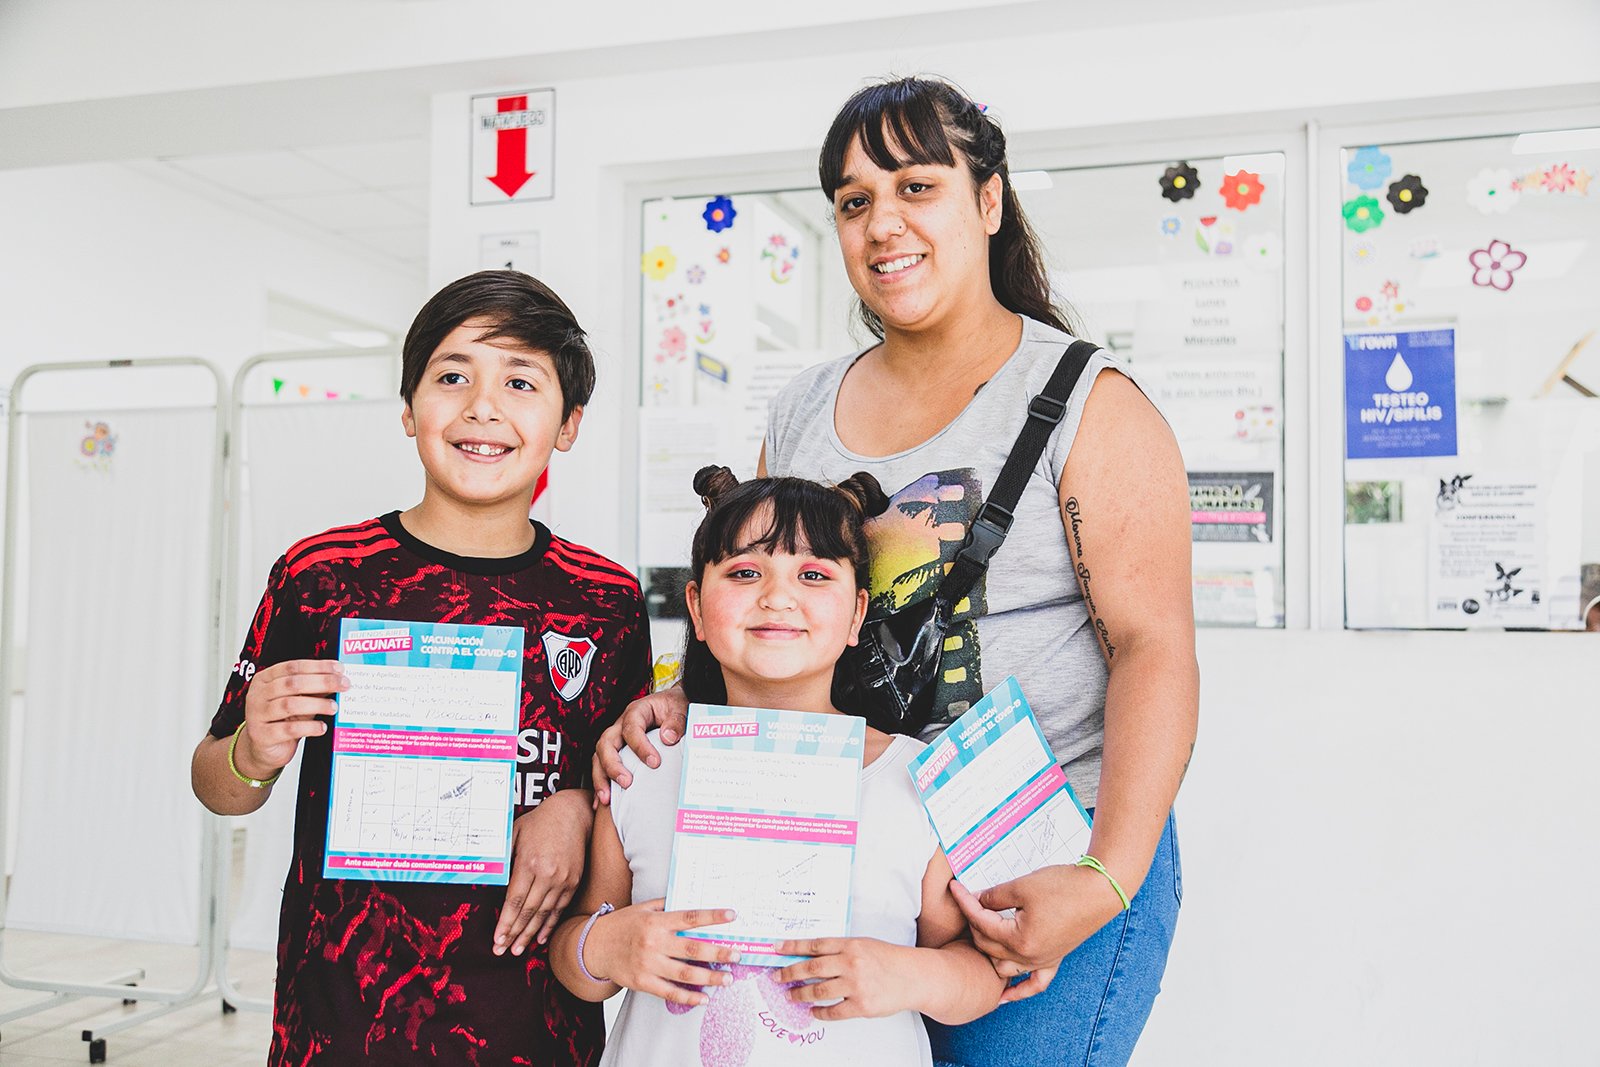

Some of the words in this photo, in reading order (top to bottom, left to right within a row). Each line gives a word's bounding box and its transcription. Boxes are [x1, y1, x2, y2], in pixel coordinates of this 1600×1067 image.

[1372, 391, 1429, 408] TESTEO
[1065, 496, 1083, 558] Morena
[345, 637, 411, 652] VACUNATE
[421, 635, 484, 646] VACUNACIÓN
[420, 645, 459, 655] CONTRA
[461, 646, 473, 656] EL
[474, 648, 518, 658] COVID-19
[694, 723, 757, 736] VACUNATE
[767, 721, 828, 733] VACUNACIÓN
[766, 731, 803, 742] CONTRA
[806, 733, 817, 743] EL
[819, 734, 860, 745] COVID-19
[963, 727, 988, 750] CONTRA
[986, 720, 996, 730] EL
[918, 745, 958, 790] VACUNATE
[345, 858, 361, 866] Ante
[362, 859, 392, 868] cualquier
[394, 860, 410, 868] duda
[411, 861, 452, 869] comunicarse
[466, 862, 472, 870] el
[759, 1011, 789, 1039] LOVE
[800, 1028, 825, 1046] YOU
